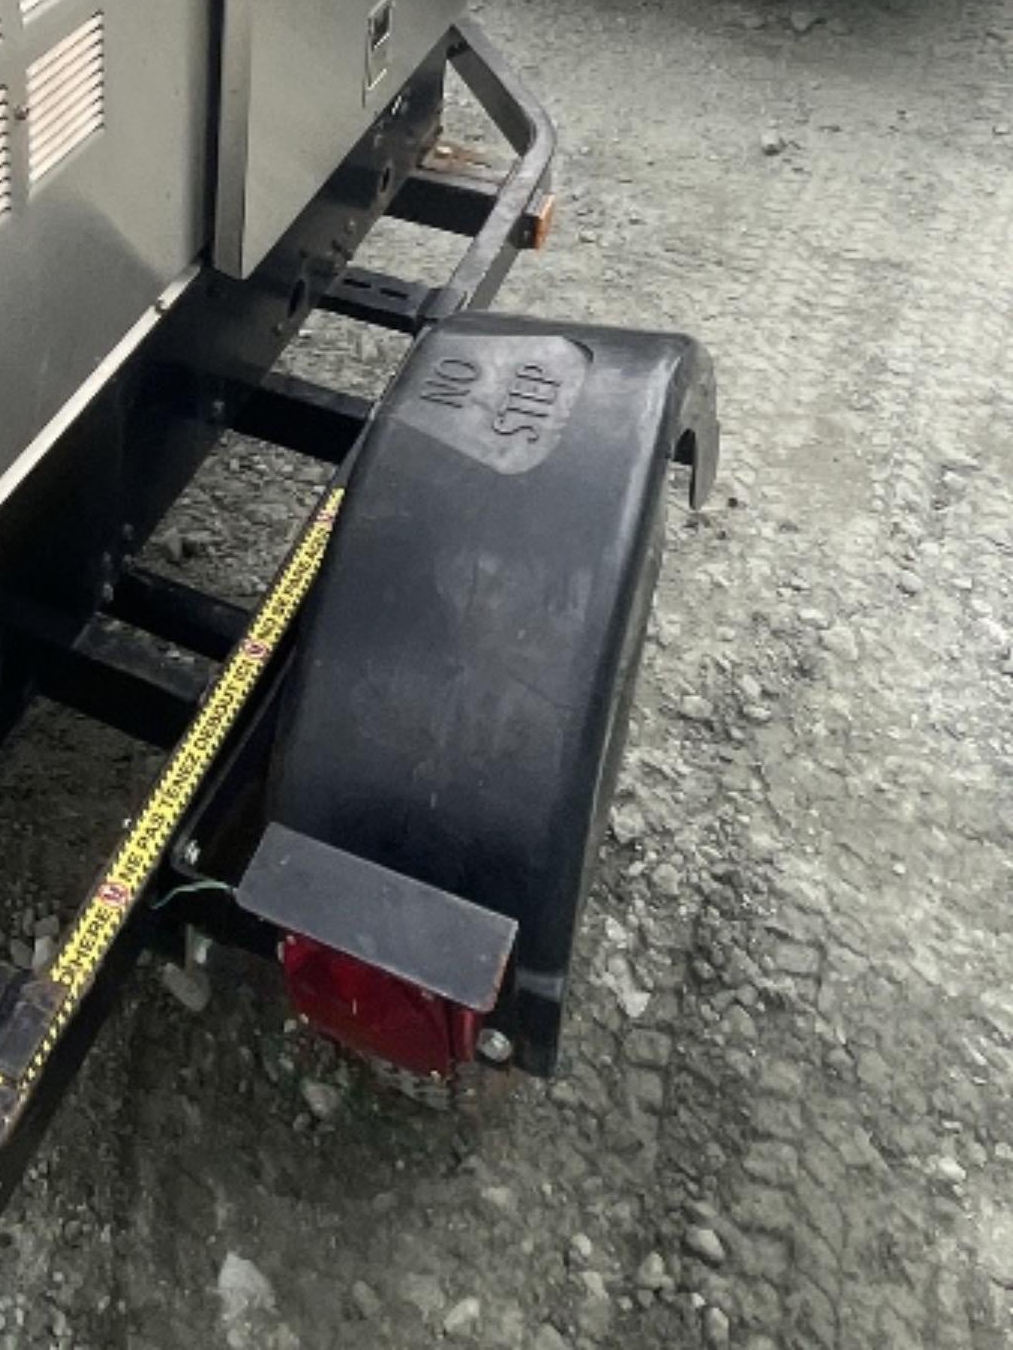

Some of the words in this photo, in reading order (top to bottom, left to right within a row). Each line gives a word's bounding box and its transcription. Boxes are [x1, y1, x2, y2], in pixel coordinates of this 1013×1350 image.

[419, 358, 479, 409] NO
[491, 364, 562, 445] STEP
[118, 853, 144, 883] NE
[136, 811, 167, 851] PAS
[158, 752, 202, 809] TENEZ
[192, 682, 240, 751] DEBOUT
